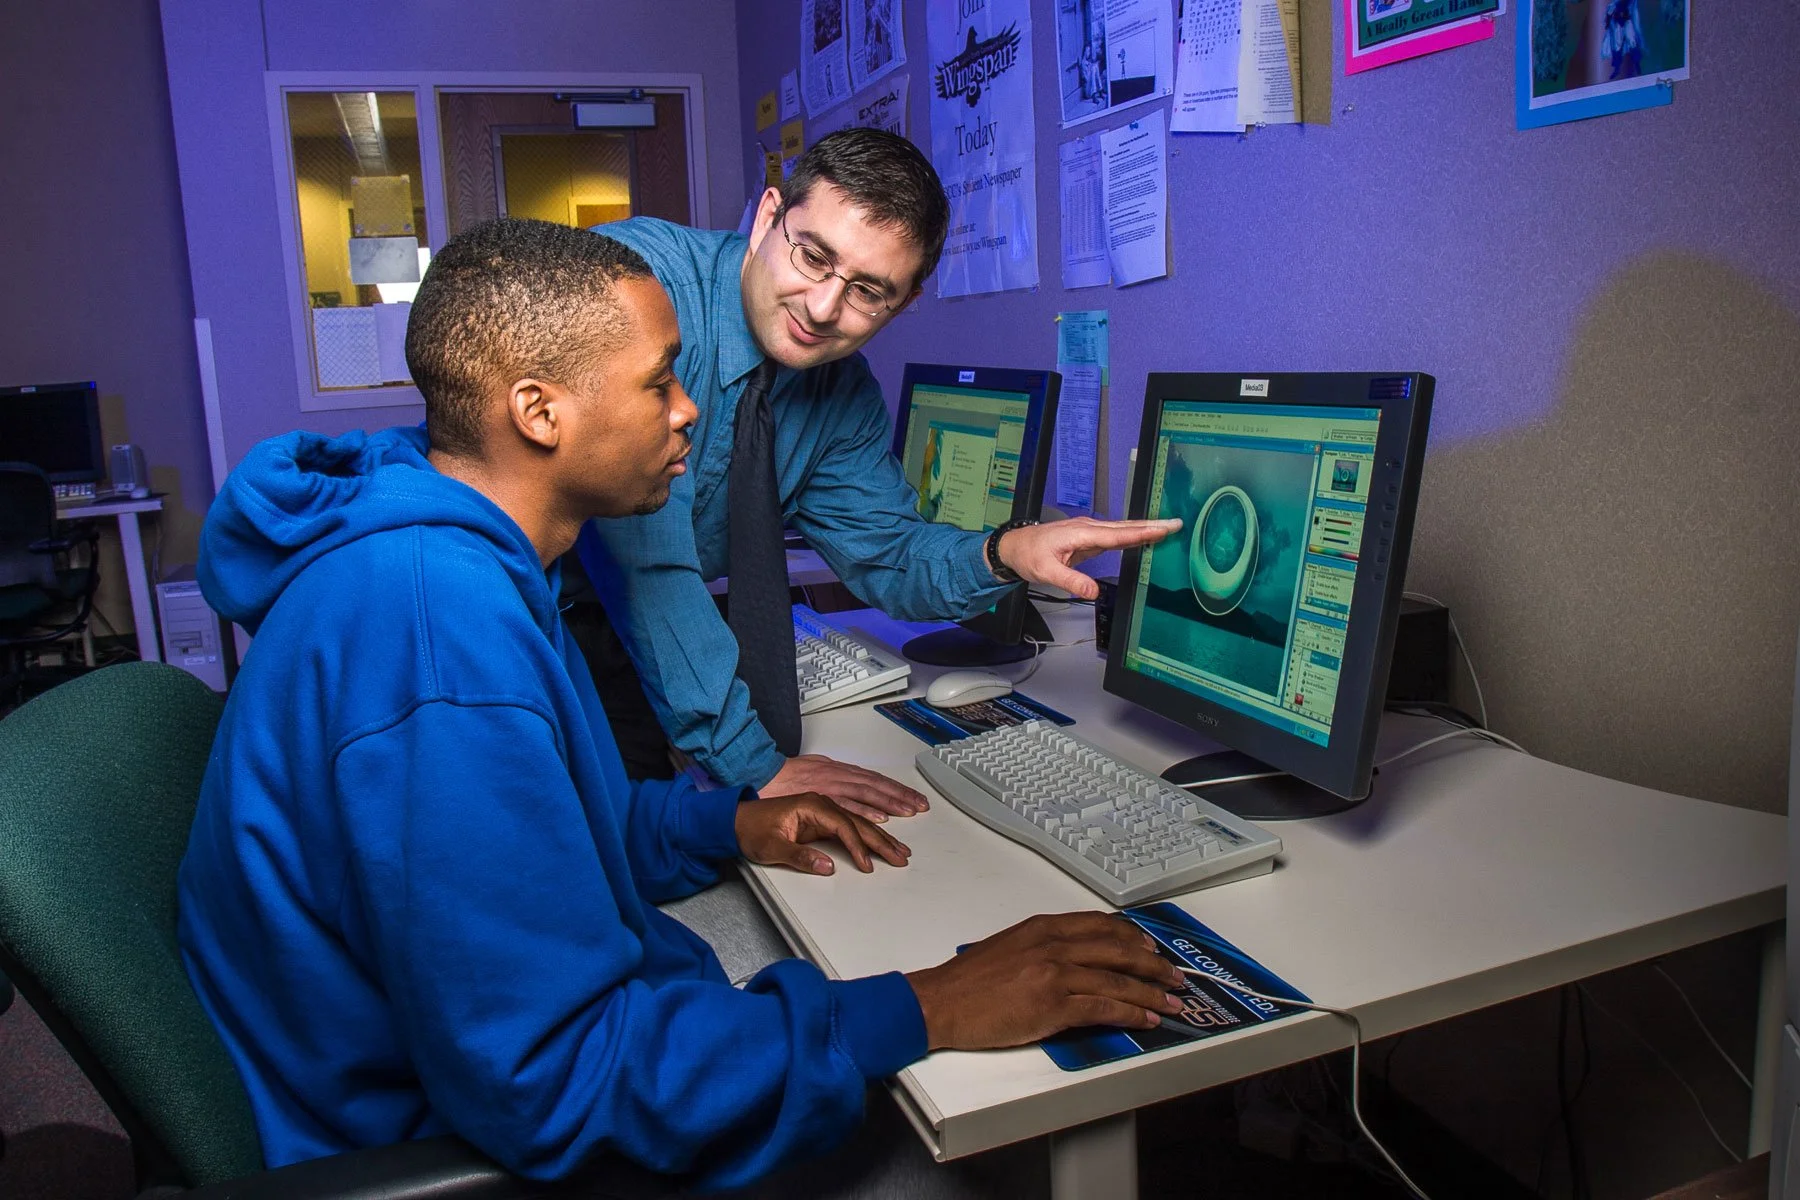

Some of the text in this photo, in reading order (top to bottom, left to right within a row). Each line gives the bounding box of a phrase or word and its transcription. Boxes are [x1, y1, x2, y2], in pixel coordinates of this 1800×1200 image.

[1375, 16, 1408, 35] Really
[1411, 6, 1445, 25] Great
[941, 44, 1014, 97] Wingspan
[858, 88, 901, 121] EXTRA!
[954, 115, 998, 157] Today
[983, 167, 1022, 187] Newspaper
[1197, 712, 1220, 727] SONY
[1171, 938, 1281, 1015] GET CONNEED!
